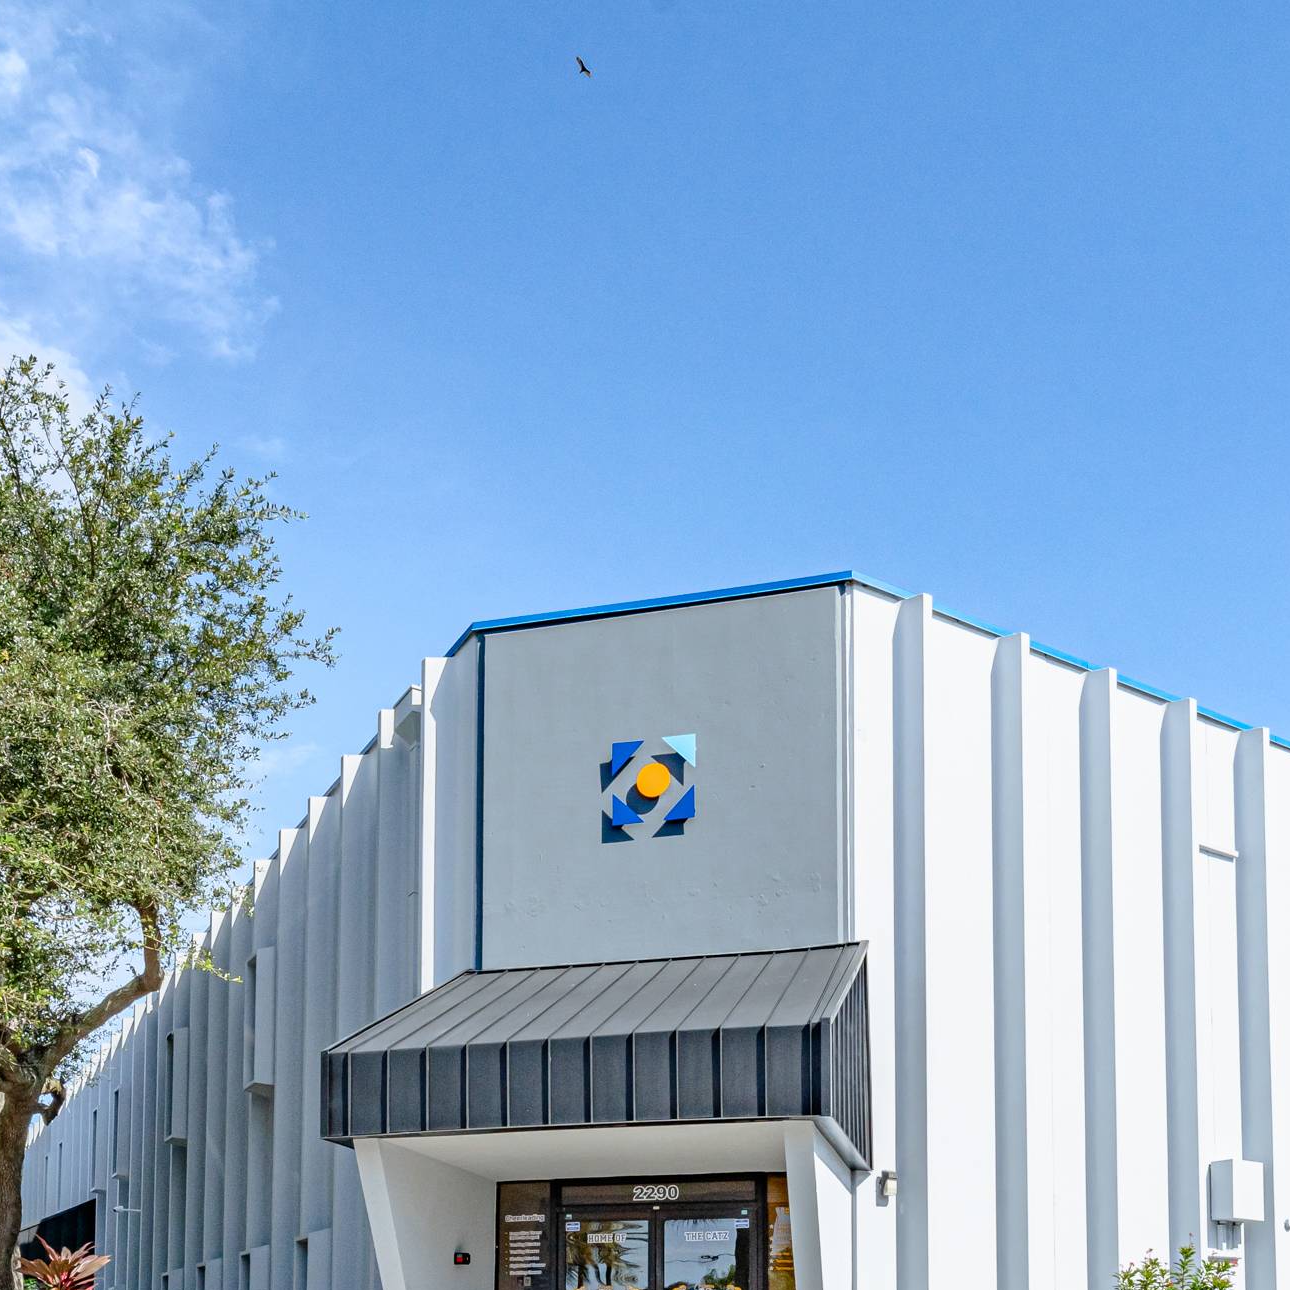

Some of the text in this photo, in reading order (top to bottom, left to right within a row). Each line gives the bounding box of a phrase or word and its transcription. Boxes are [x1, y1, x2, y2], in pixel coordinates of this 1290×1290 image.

[633, 1185, 680, 1201] 2290
[505, 1214, 545, 1222] Cheerleading
[587, 1233, 627, 1244] HOME OF
[685, 1230, 730, 1242] THE CATZ
